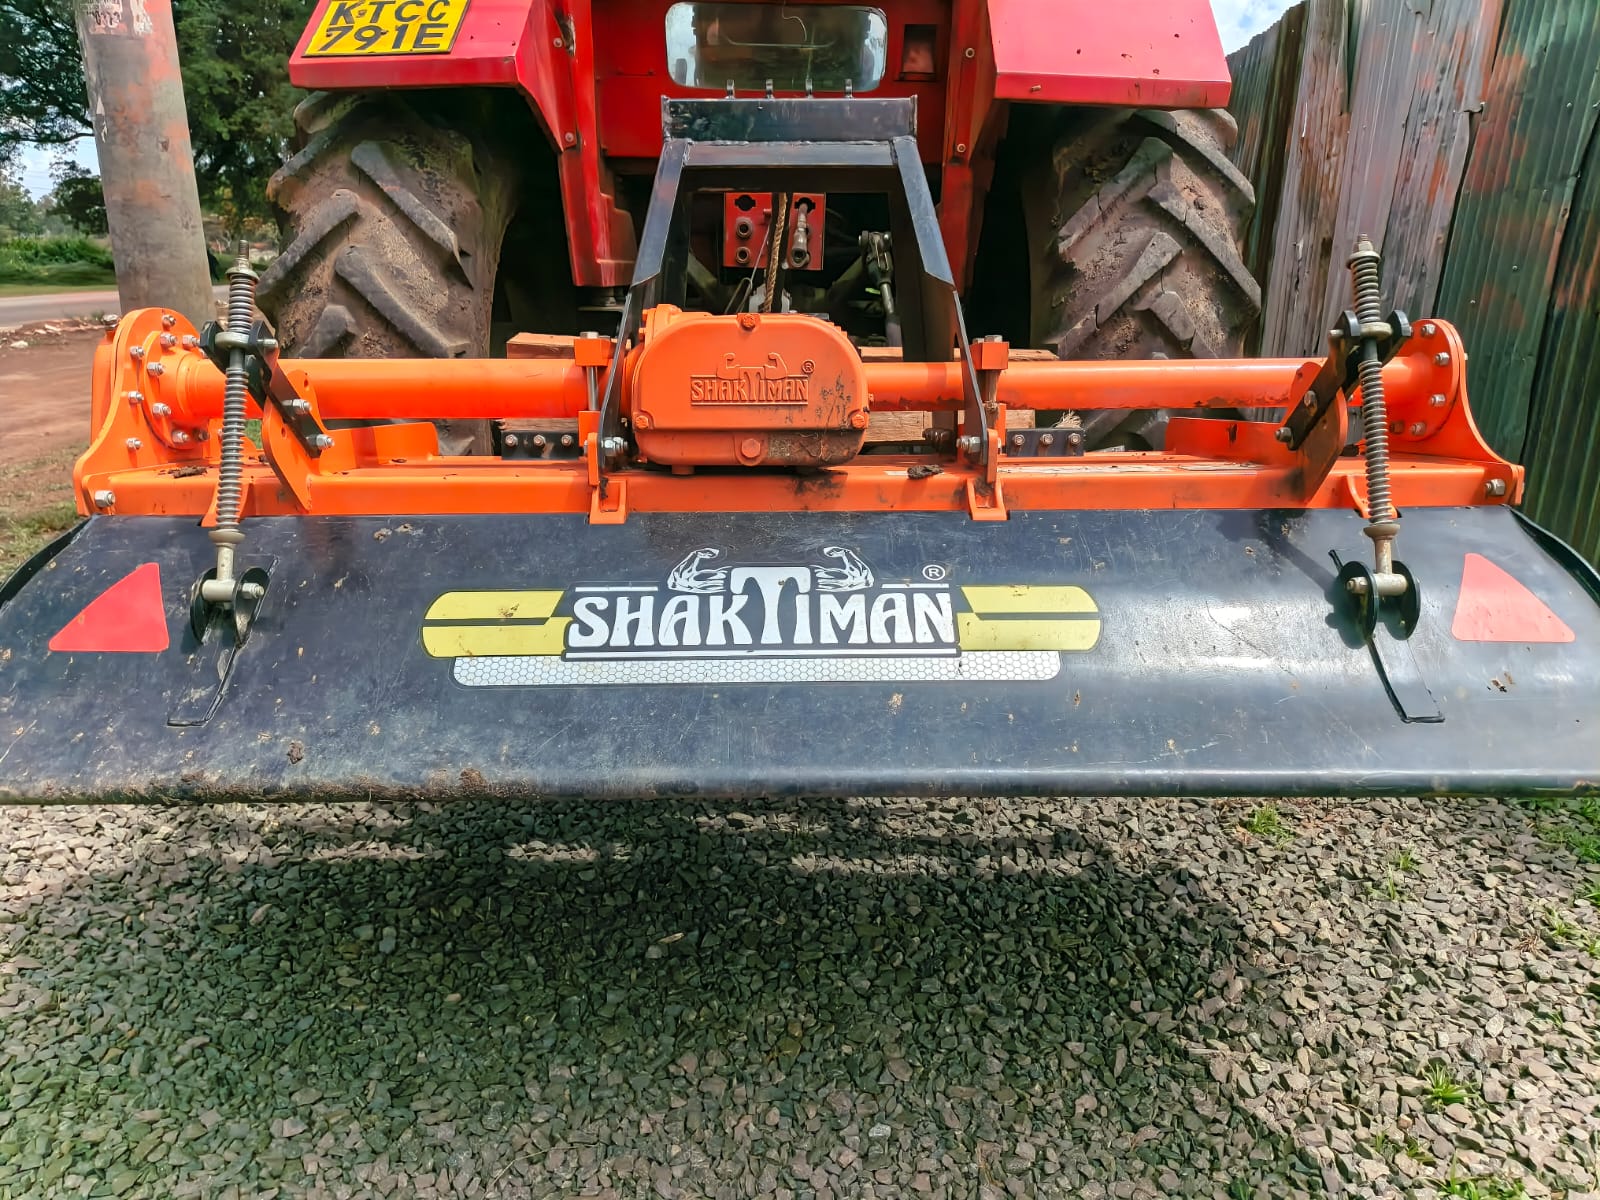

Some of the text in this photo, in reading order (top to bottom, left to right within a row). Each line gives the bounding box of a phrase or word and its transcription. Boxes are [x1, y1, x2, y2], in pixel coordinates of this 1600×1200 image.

[329, 0, 449, 25] KTCC
[318, 23, 449, 51] 791E
[691, 367, 808, 401] SHAKTIMAN
[568, 567, 956, 647] SHAKTIMAN
